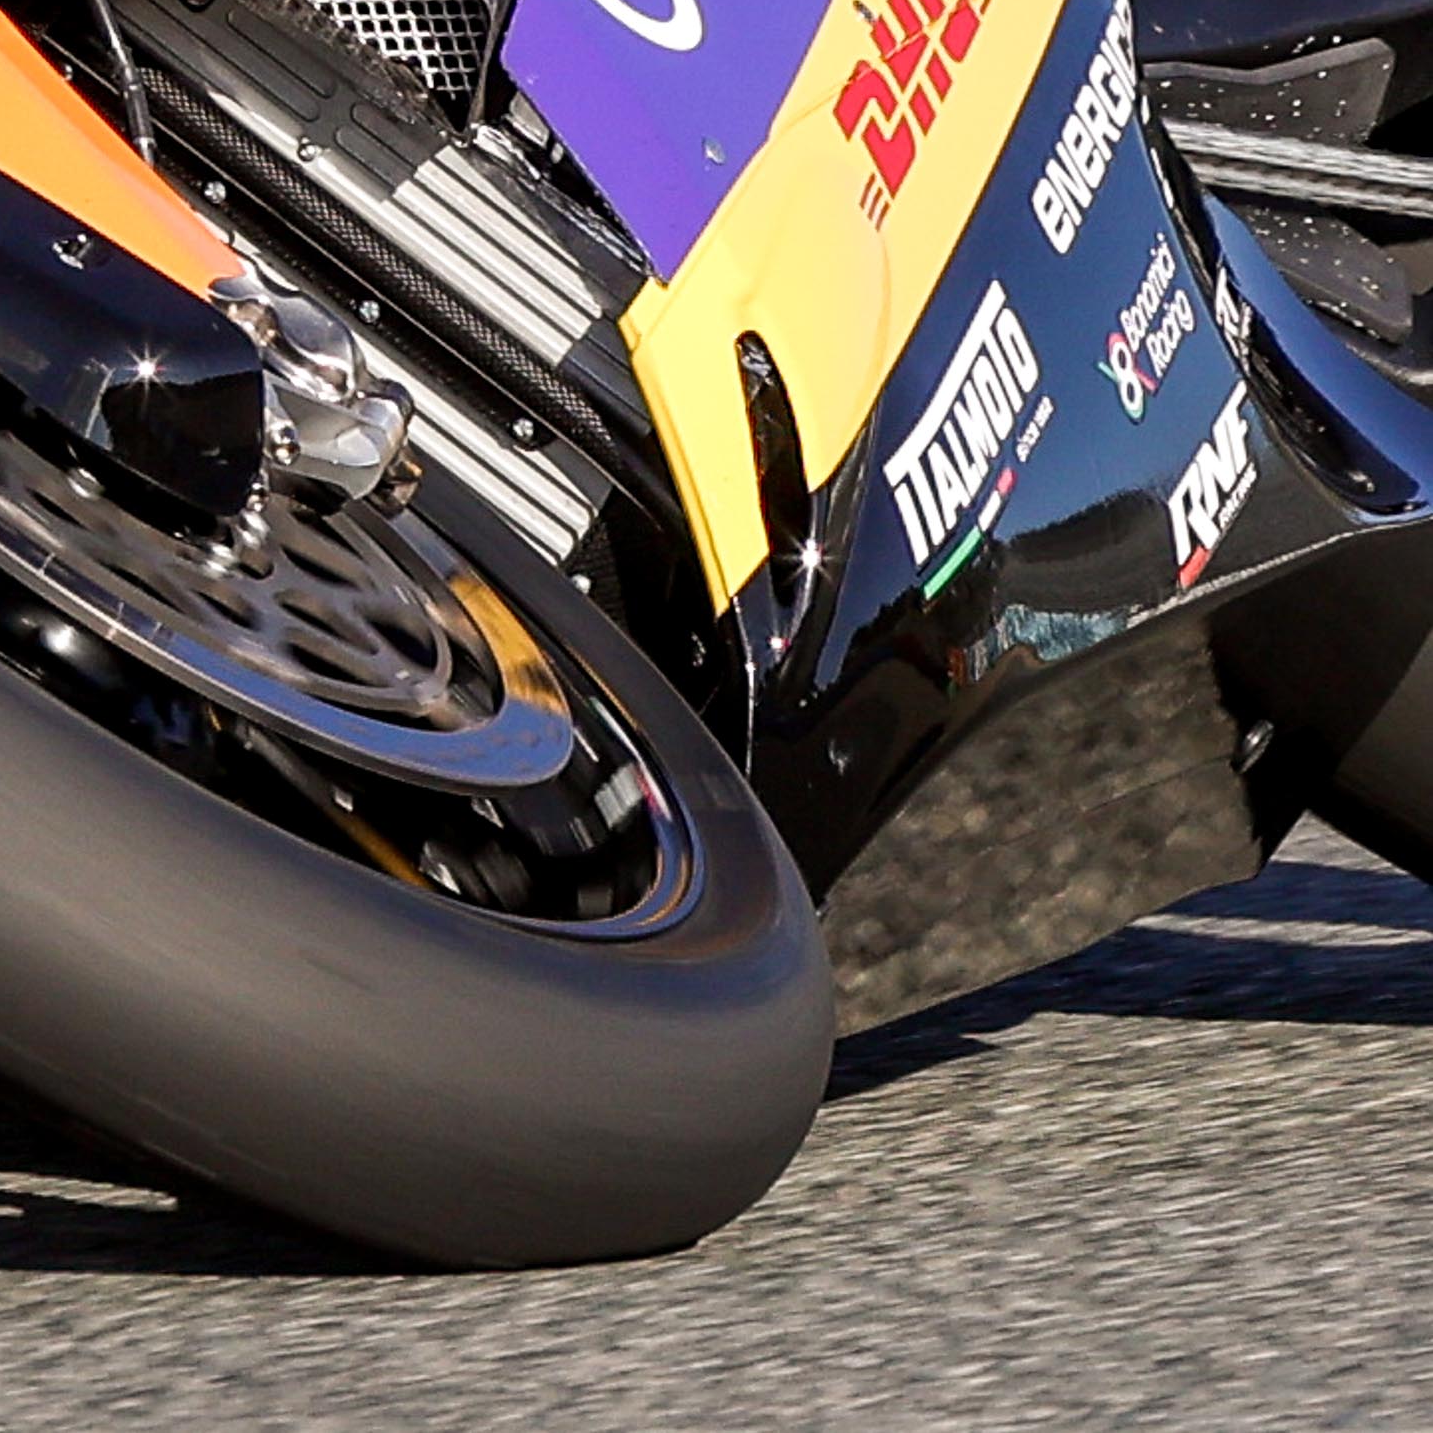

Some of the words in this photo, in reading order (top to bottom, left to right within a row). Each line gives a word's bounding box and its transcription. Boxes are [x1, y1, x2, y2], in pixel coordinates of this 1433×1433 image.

[1118, 231, 1176, 355] Bonamici
[1146, 287, 1196, 378] Racing
[1167, 378, 1248, 567] RNF
